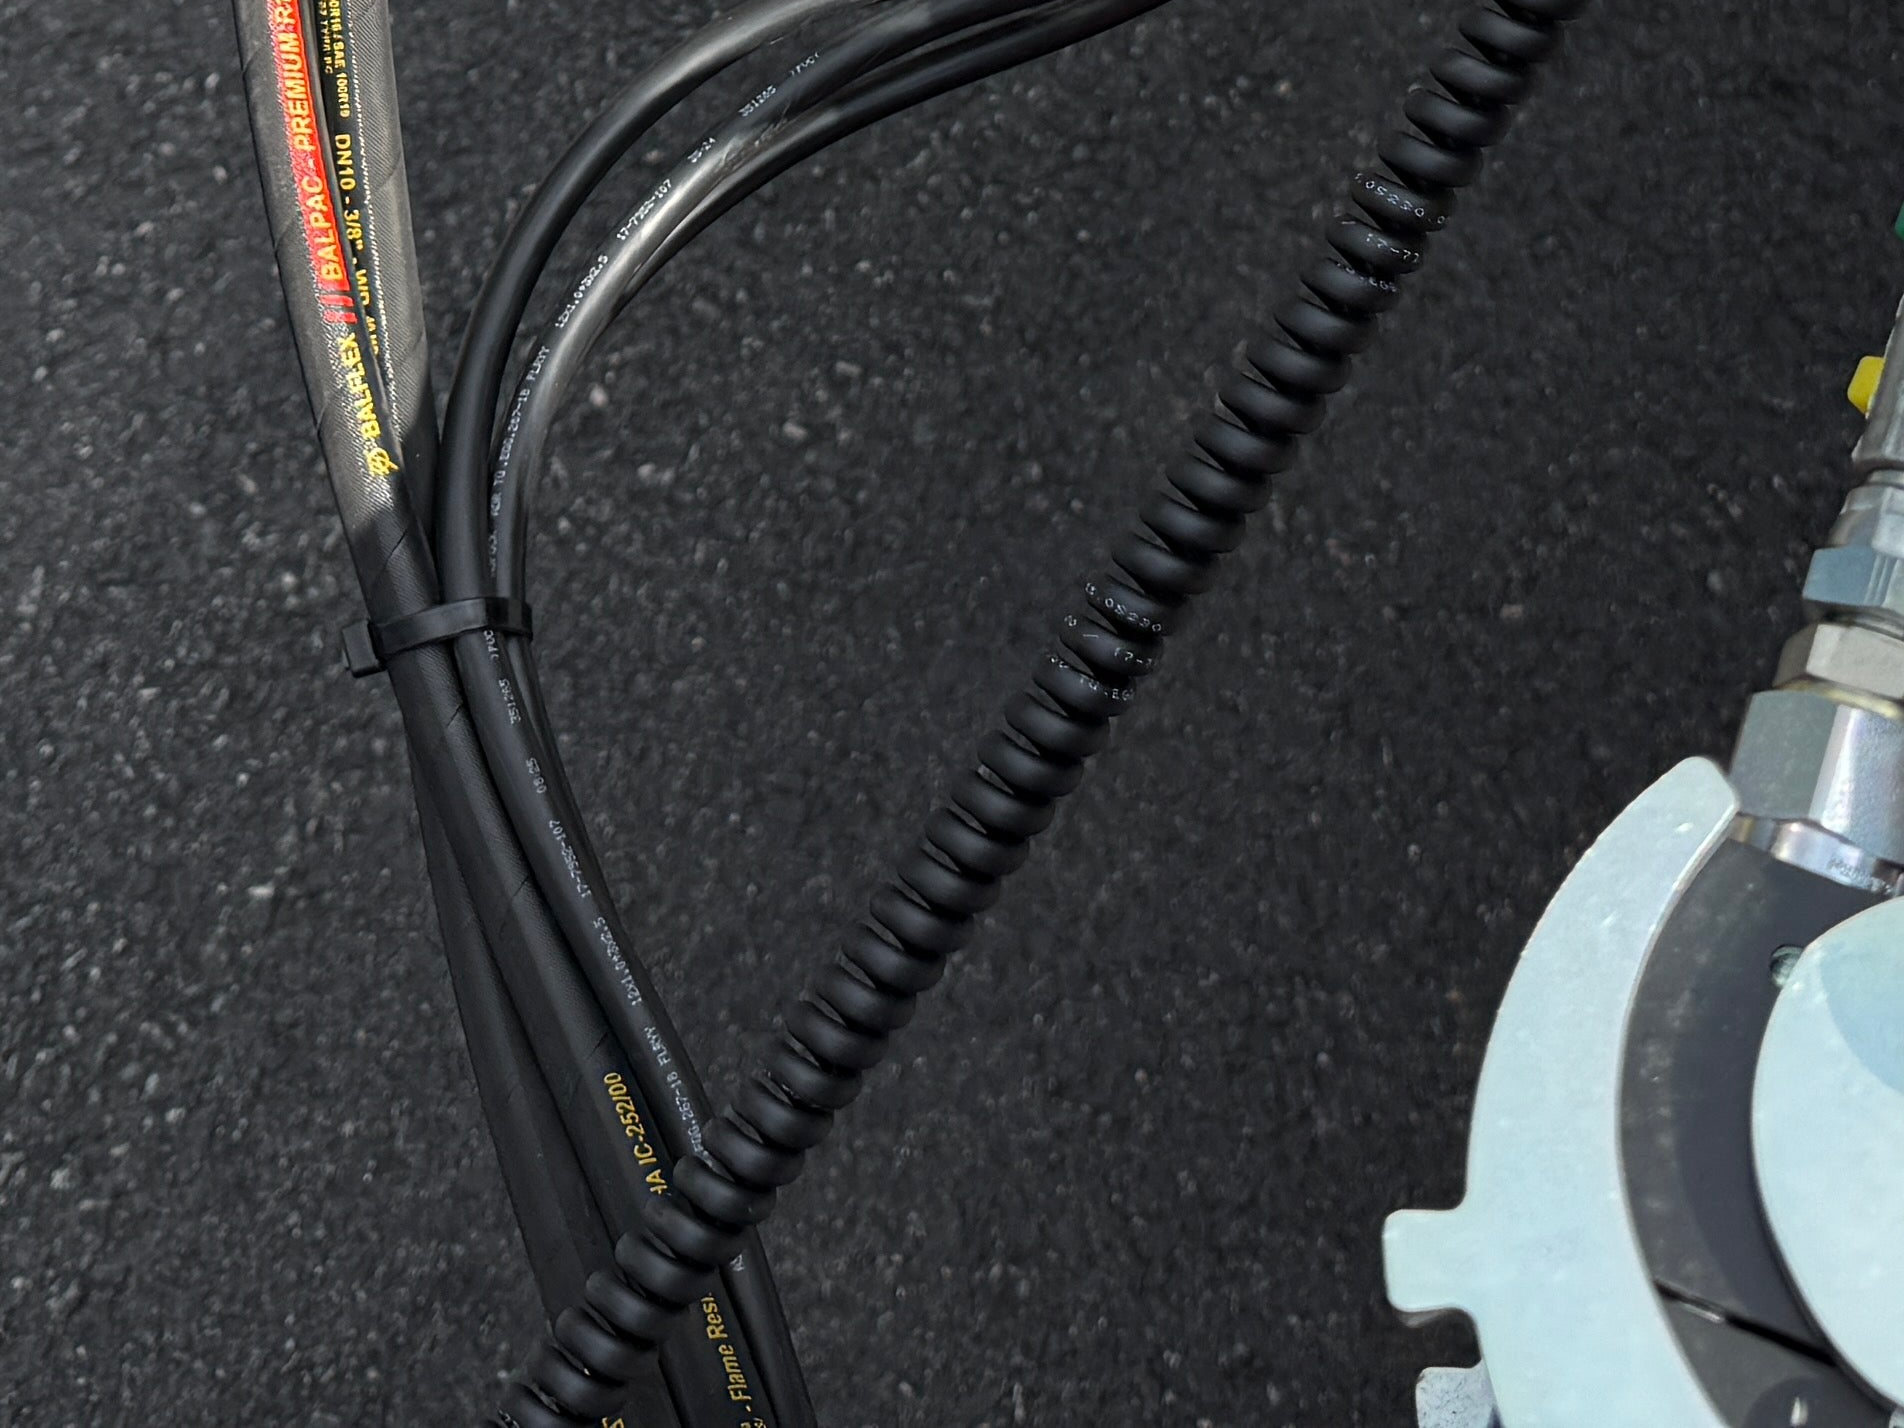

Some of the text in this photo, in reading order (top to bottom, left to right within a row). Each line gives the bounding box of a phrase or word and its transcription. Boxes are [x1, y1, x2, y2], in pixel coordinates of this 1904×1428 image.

[276, 31, 317, 152] PREMIUM
[334, 133, 358, 191] DN10
[300, 174, 344, 282] BALPAC
[343, 208, 365, 251] 3/8"
[336, 331, 383, 440] BALFLEX
[603, 1071, 658, 1167] IC-252/00
[718, 1343, 752, 1402] Flame
